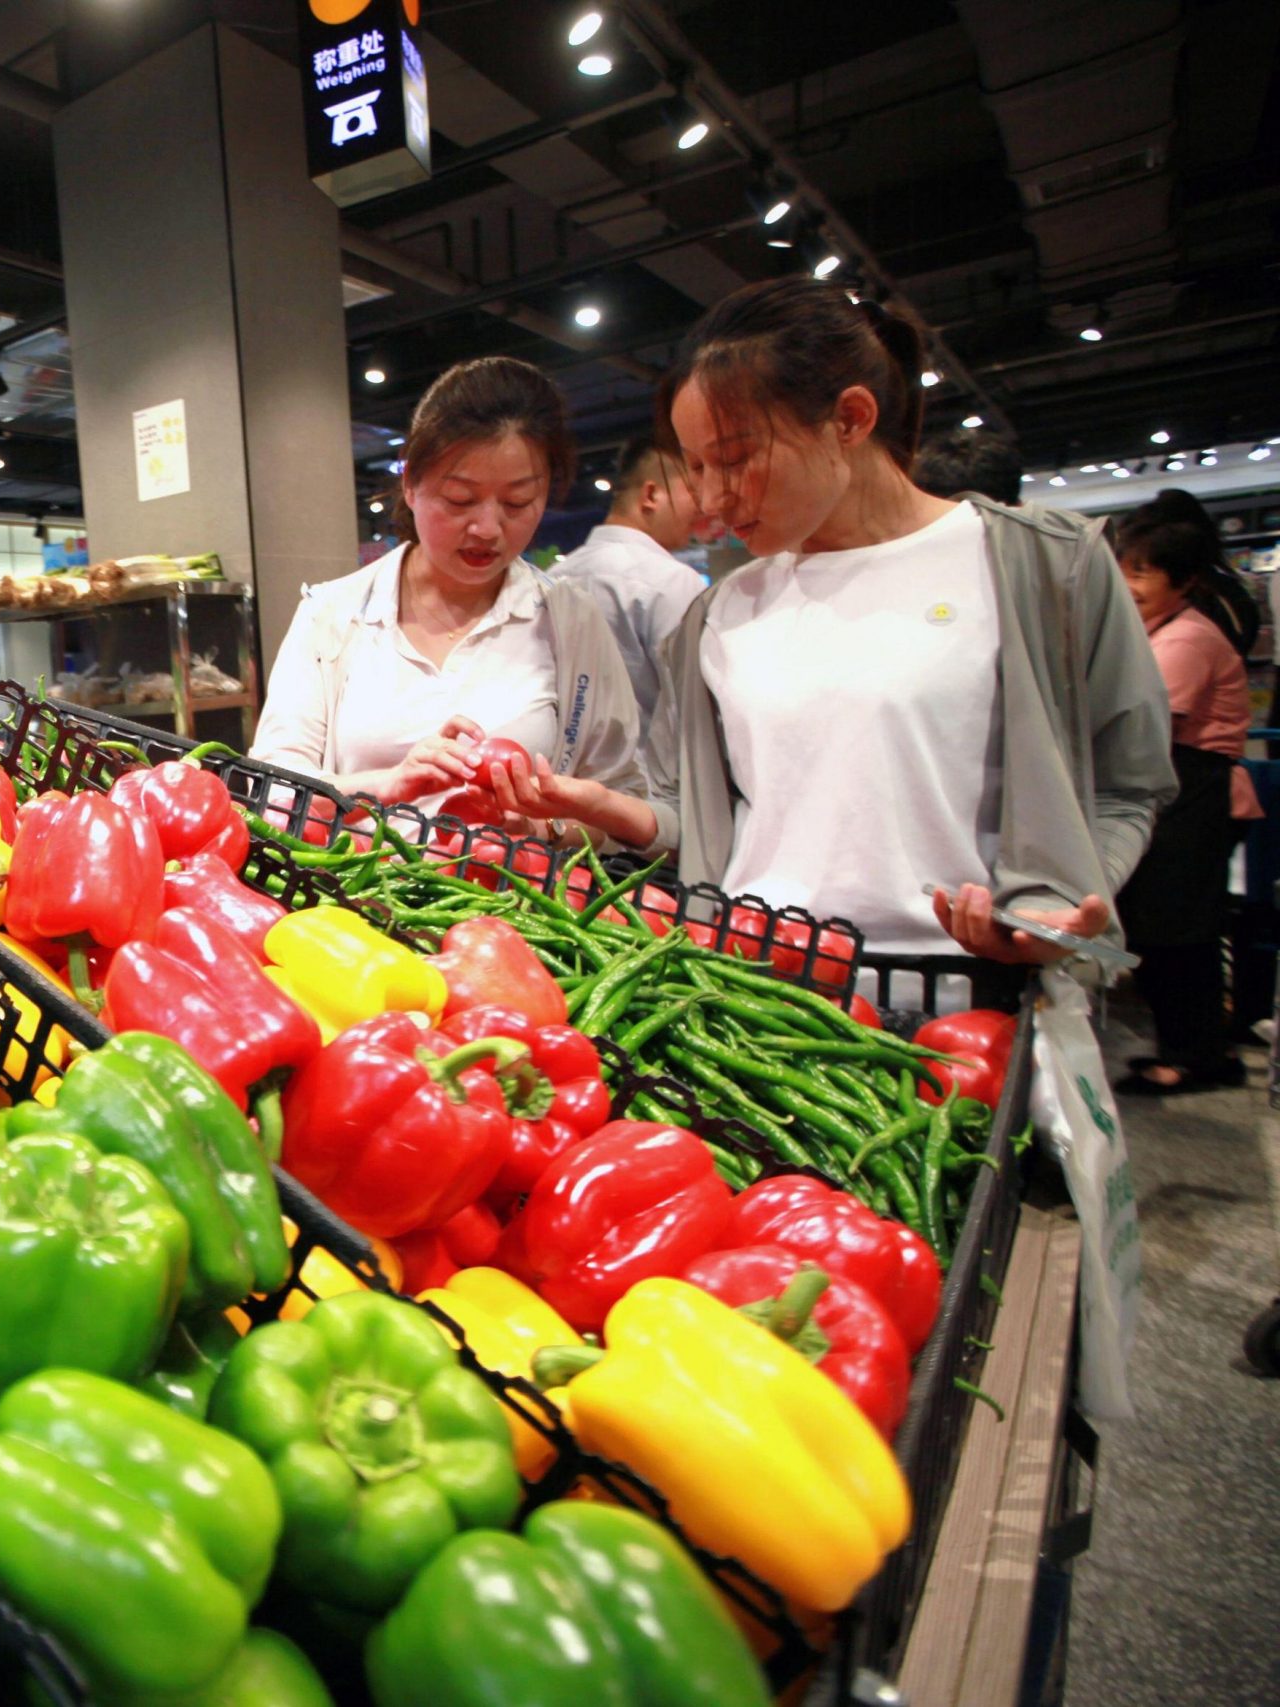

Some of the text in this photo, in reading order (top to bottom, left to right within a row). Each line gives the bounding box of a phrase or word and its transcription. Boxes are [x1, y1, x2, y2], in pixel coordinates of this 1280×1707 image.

[313, 29, 385, 75] 称重处
[316, 58, 385, 90] Weighing
[564, 674, 589, 745] Challenge
